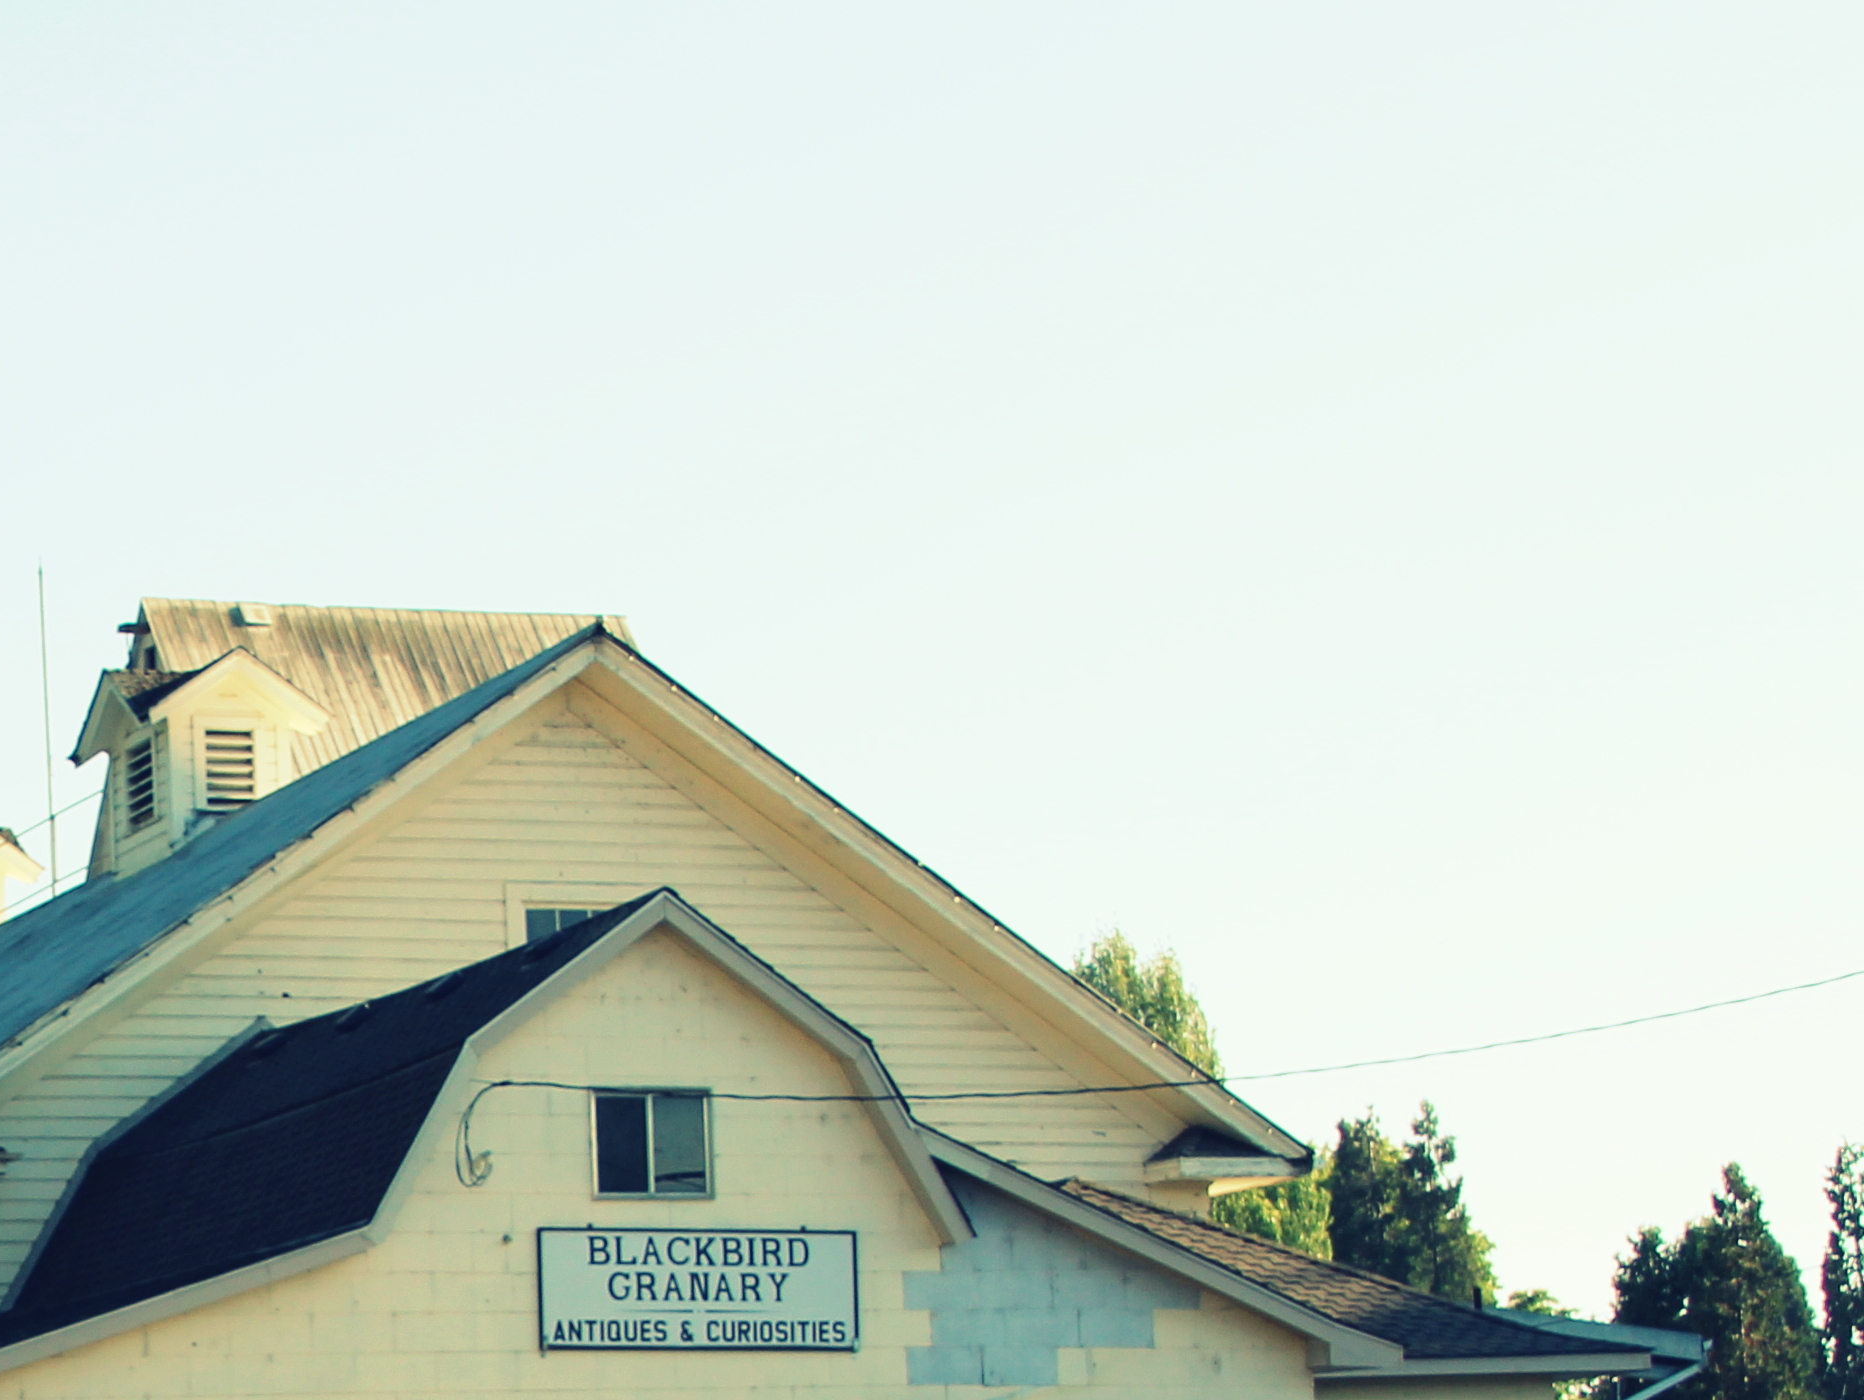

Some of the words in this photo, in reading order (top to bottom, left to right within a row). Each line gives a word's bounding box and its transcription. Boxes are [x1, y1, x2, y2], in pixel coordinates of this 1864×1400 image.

[587, 1235, 810, 1267] BLACKBIRD
[607, 1271, 790, 1302] GRANARY
[553, 1319, 668, 1342] ANTIQUES
[679, 1320, 694, 1342] &
[706, 1320, 846, 1343] CURIOSITIES
